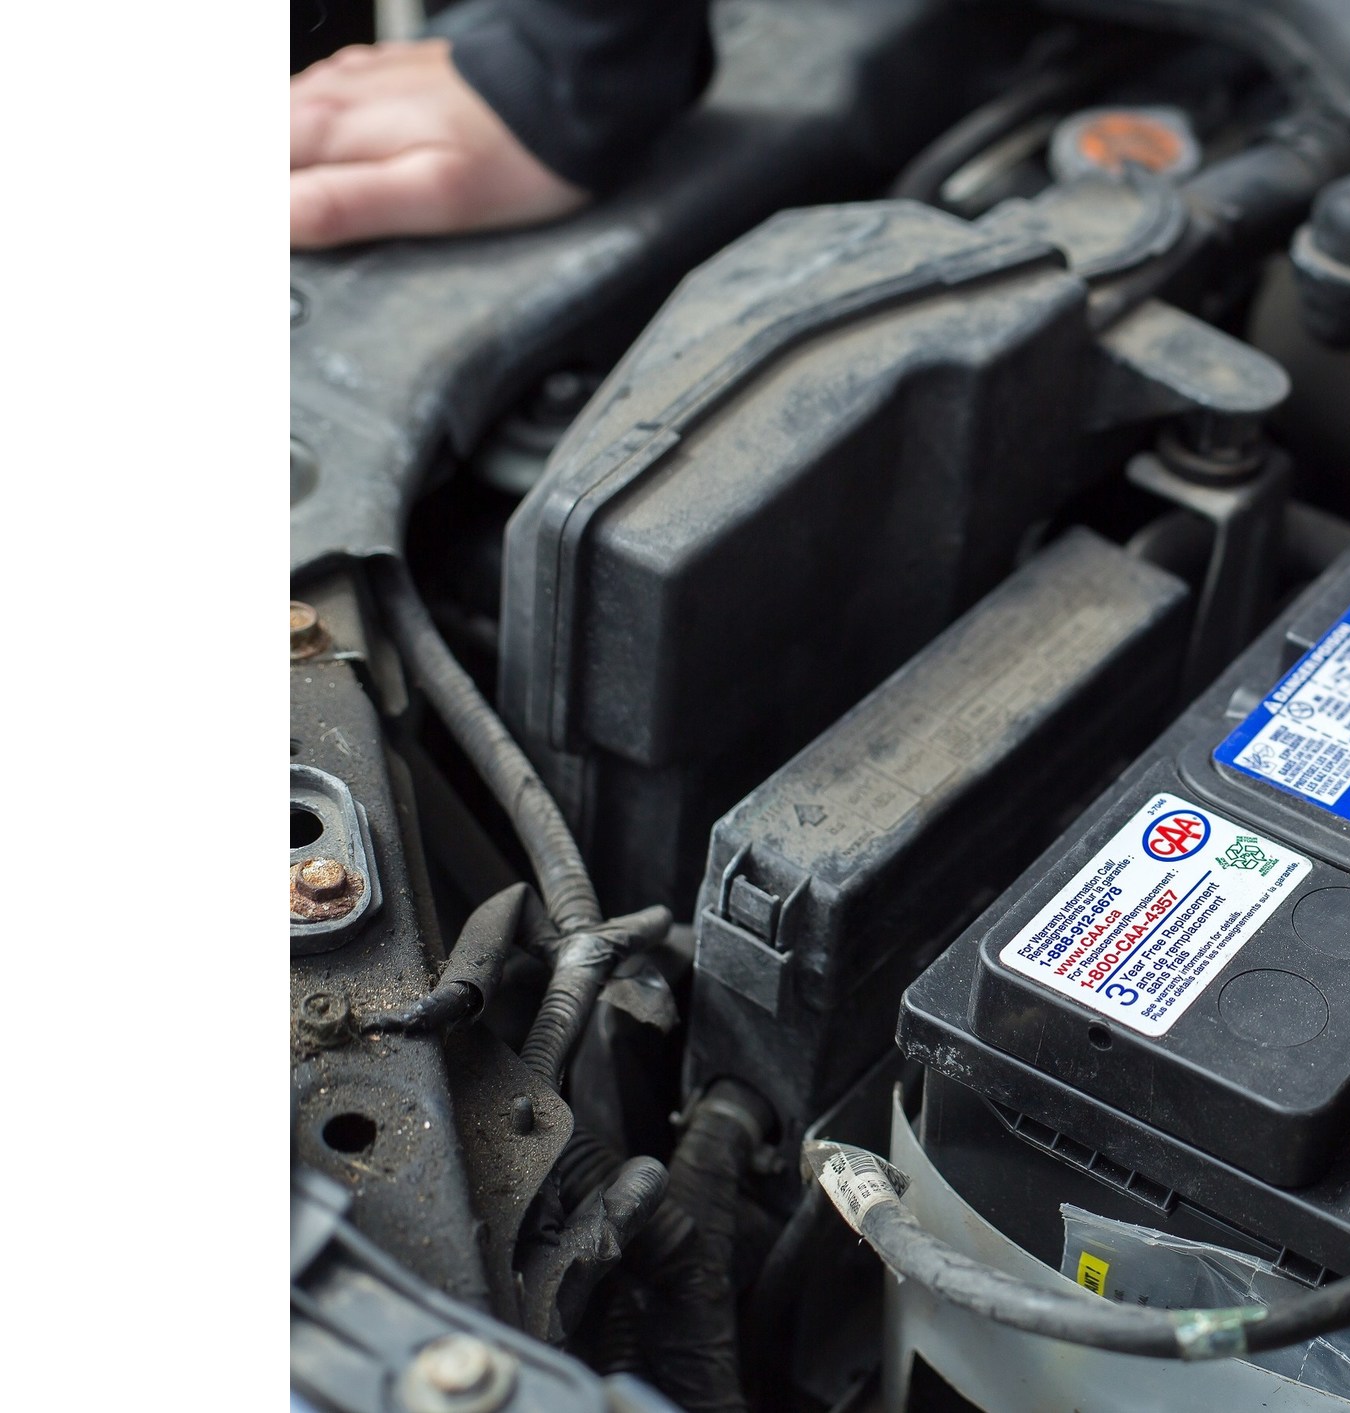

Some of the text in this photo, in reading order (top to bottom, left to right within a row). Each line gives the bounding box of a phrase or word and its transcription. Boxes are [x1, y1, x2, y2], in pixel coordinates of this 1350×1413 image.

[1151, 818, 1201, 855] CAA
[1016, 858, 1115, 957] For Warranty Information Call/
[1025, 904, 1085, 961] Renseignements
[1082, 892, 1096, 905] sur
[1091, 885, 1105, 893] la
[1101, 858, 1130, 887] garantie
[1039, 886, 1122, 967] 1-888-912-6678
[1053, 909, 1122, 975] www.CAA.ca
[1066, 967, 1083, 981] For
[1078, 872, 1175, 968] Replacement/Remplacement
[1080, 888, 1177, 988] 1-800-CAA-4357
[1118, 881, 1219, 981] Year Free Replacement
[1135, 895, 1226, 989] ans de remplacement
[1149, 1006, 1167, 1021] Plus
[1164, 996, 1175, 1006] de
[1173, 975, 1195, 997] détails
[1192, 959, 1209, 975] dans
[1204, 949, 1218, 960] les
[1215, 902, 1261, 950] renseignements
[1258, 892, 1269, 903] sur
[1274, 862, 1299, 887] garantie.
[1104, 983, 1139, 1006] 3
[1140, 911, 1242, 1017] See warranty information for details.
[1146, 950, 1190, 994] sans frais
